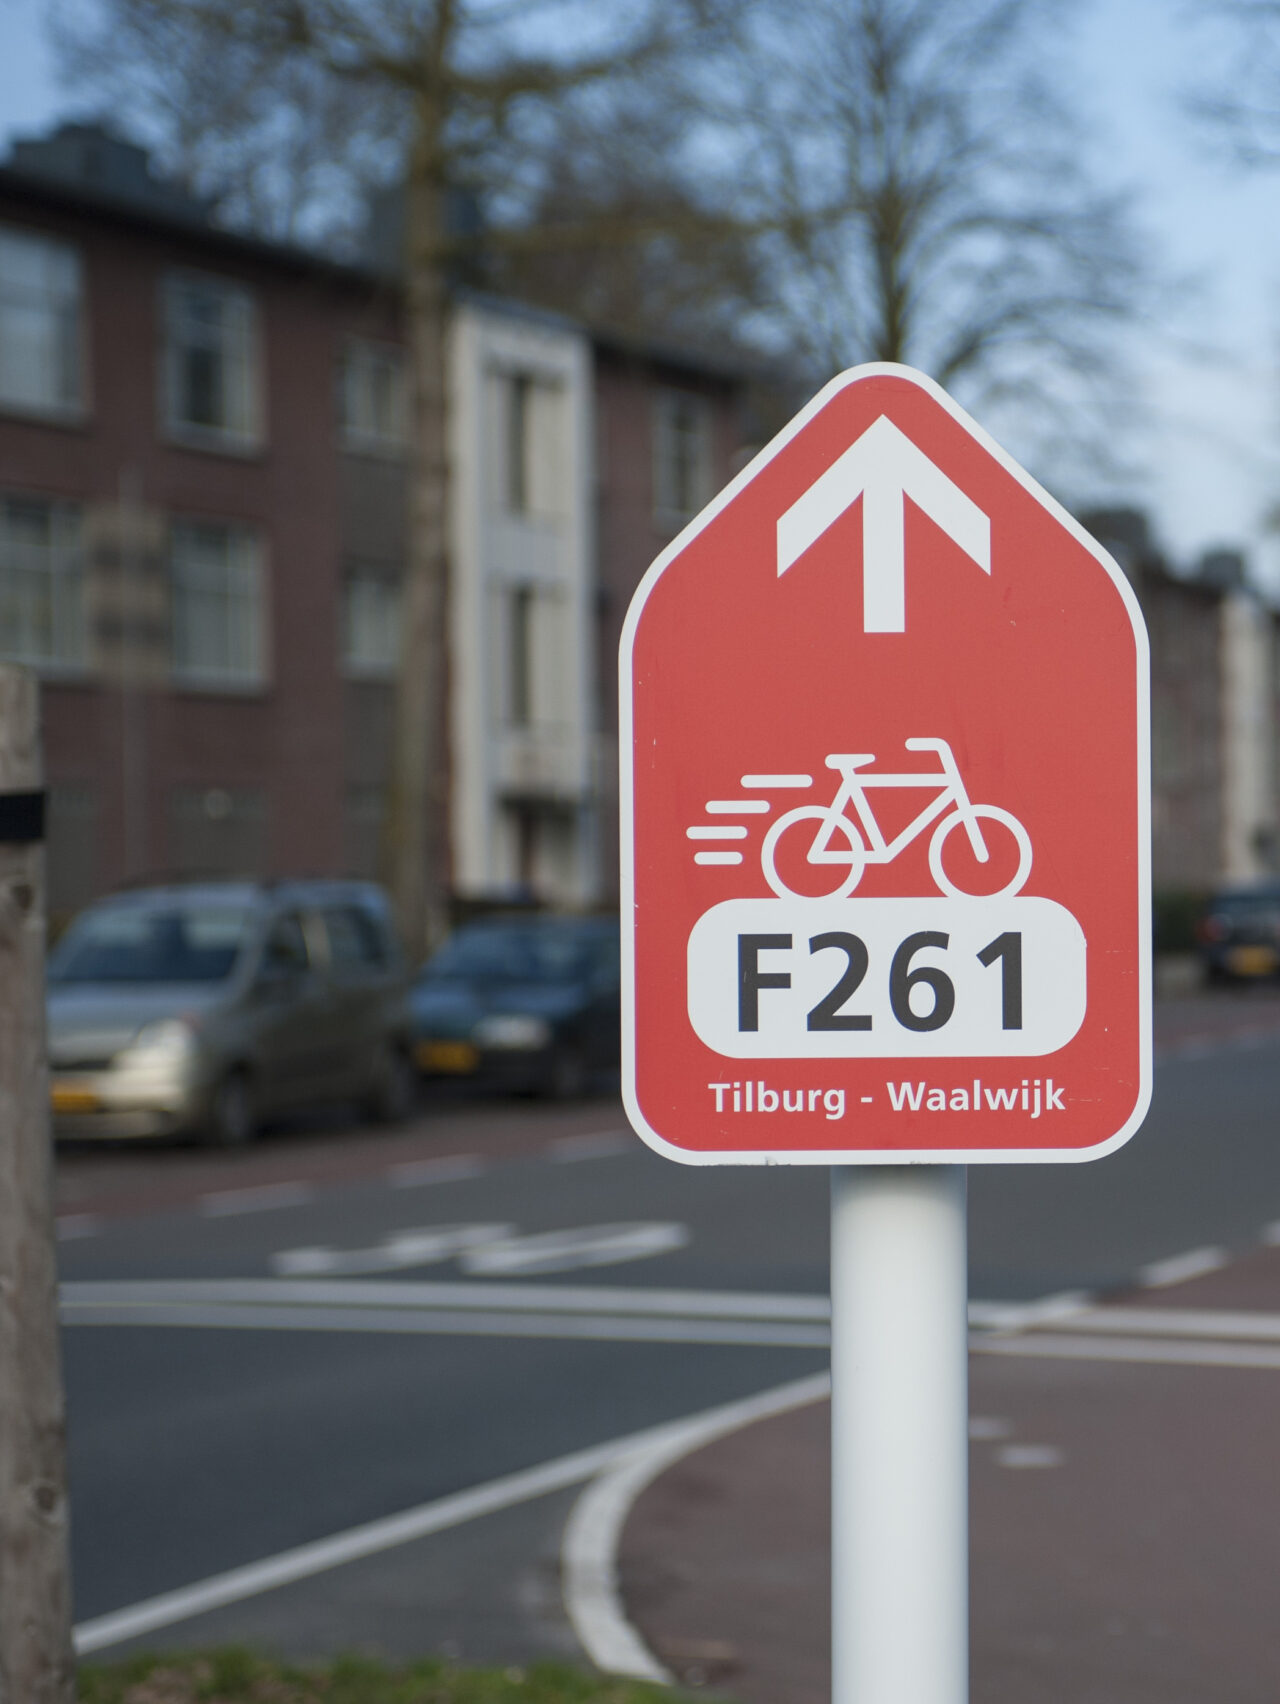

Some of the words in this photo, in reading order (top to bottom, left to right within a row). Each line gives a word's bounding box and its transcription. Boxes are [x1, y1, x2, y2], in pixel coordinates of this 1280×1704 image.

[738, 930, 1023, 1032] F261
[708, 1079, 845, 1120] Tilburg
[886, 1079, 1066, 1119] Waalwijk
